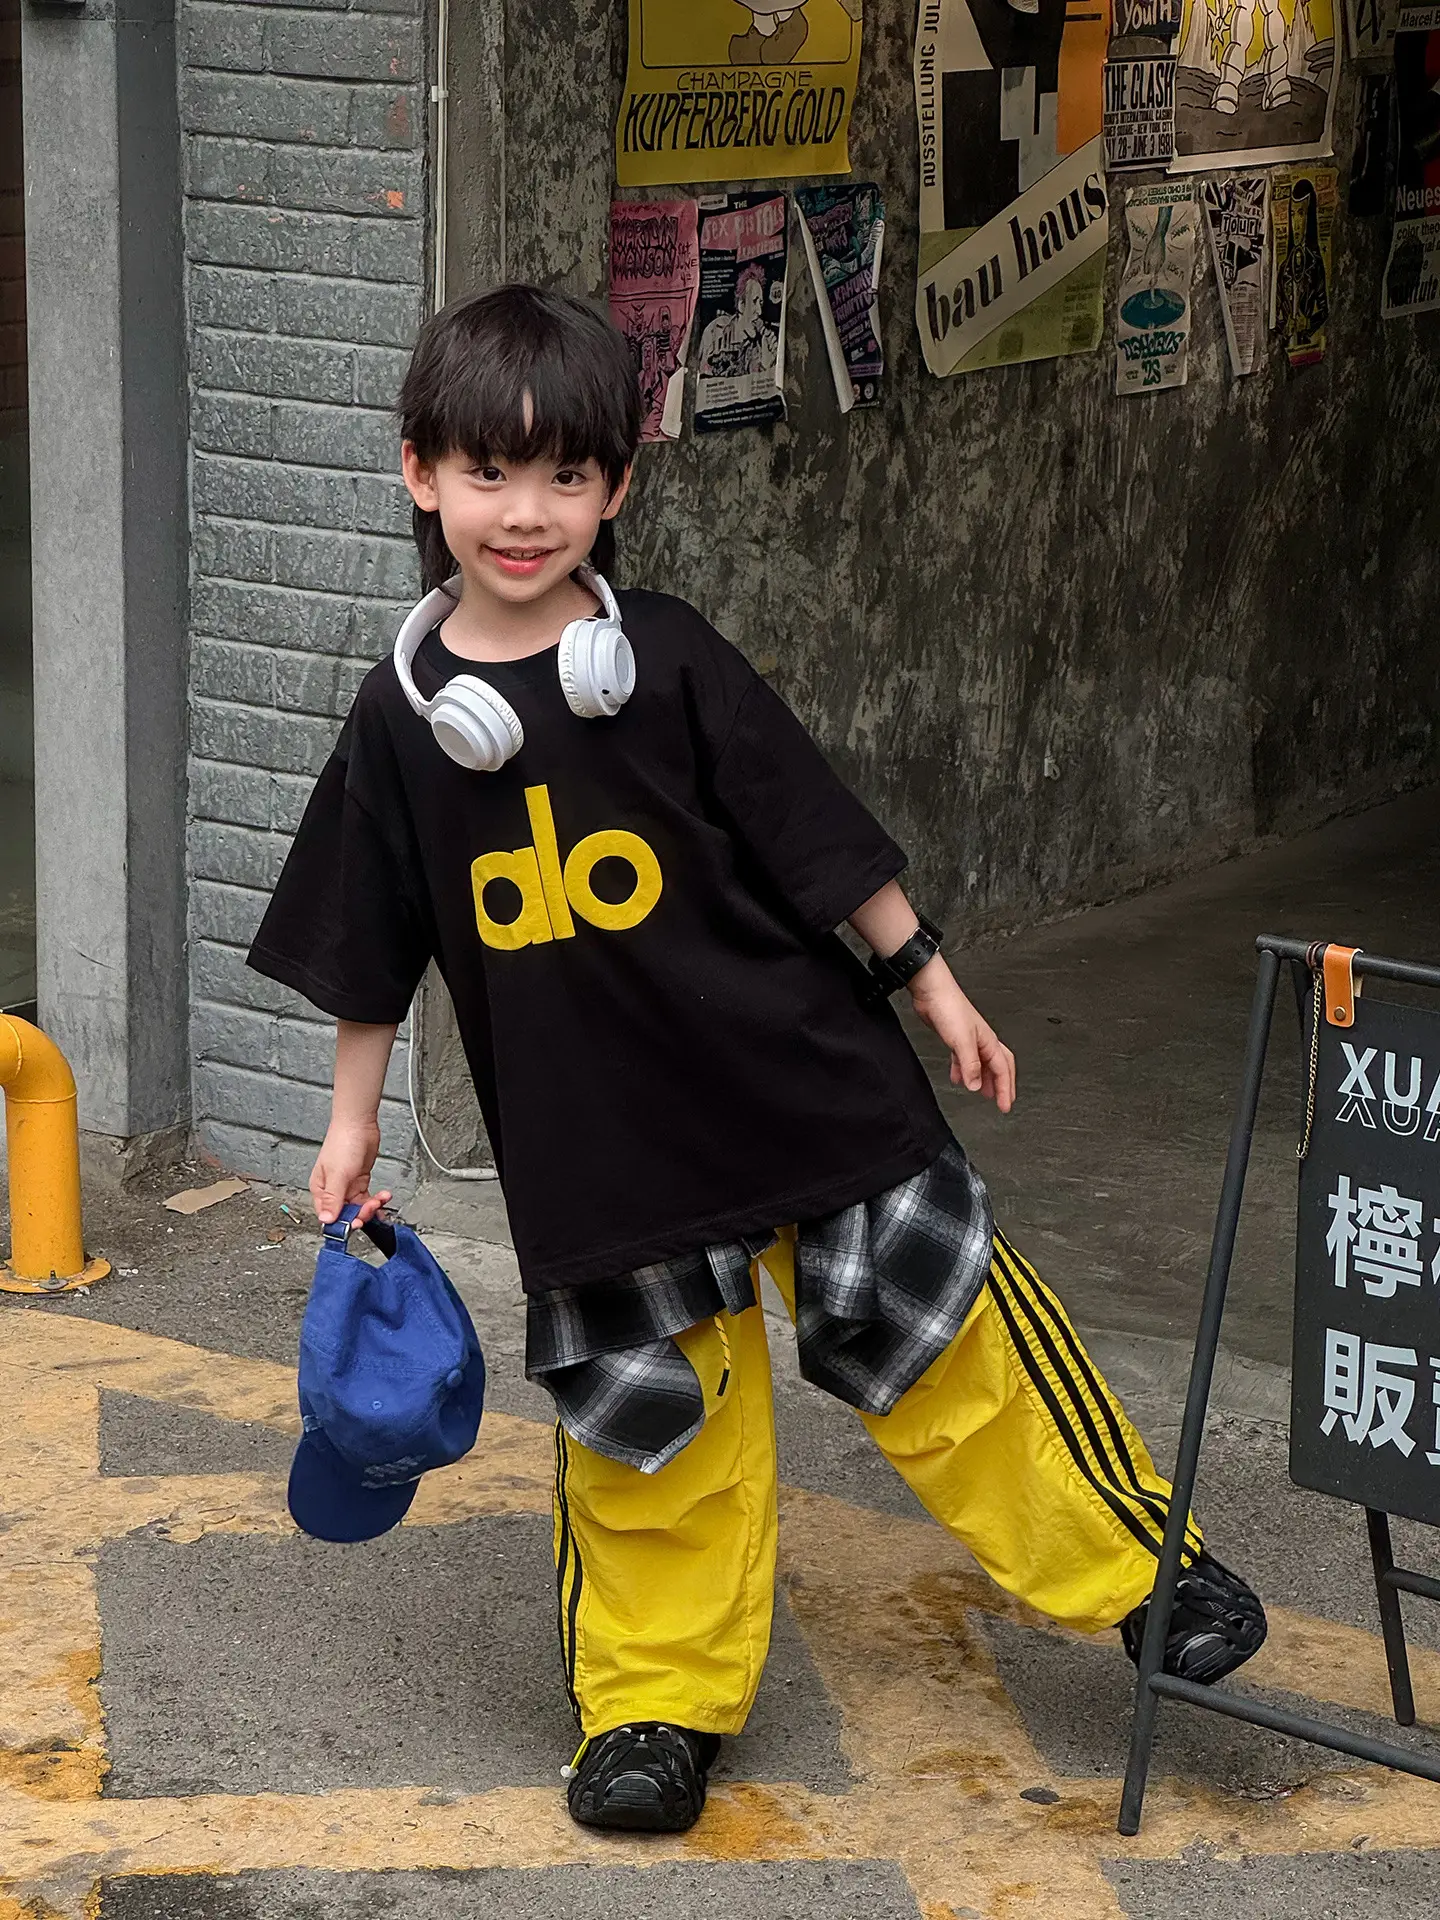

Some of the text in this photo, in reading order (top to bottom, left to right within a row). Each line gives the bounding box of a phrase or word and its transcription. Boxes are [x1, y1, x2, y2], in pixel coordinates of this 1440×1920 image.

[677, 70, 813, 91] CHAMPAGNE
[1104, 61, 1176, 112] THE CLASH
[623, 87, 845, 152] KUPFERBERG GOLD
[920, 43, 936, 188] AUSSTELLUNG
[733, 200, 748, 209] THE
[1396, 184, 1440, 213] Neues
[924, 254, 1003, 347] bau
[1007, 172, 1106, 283] haus
[1326, 1174, 1440, 1298] 檸
[1319, 1327, 1440, 1466] 販
